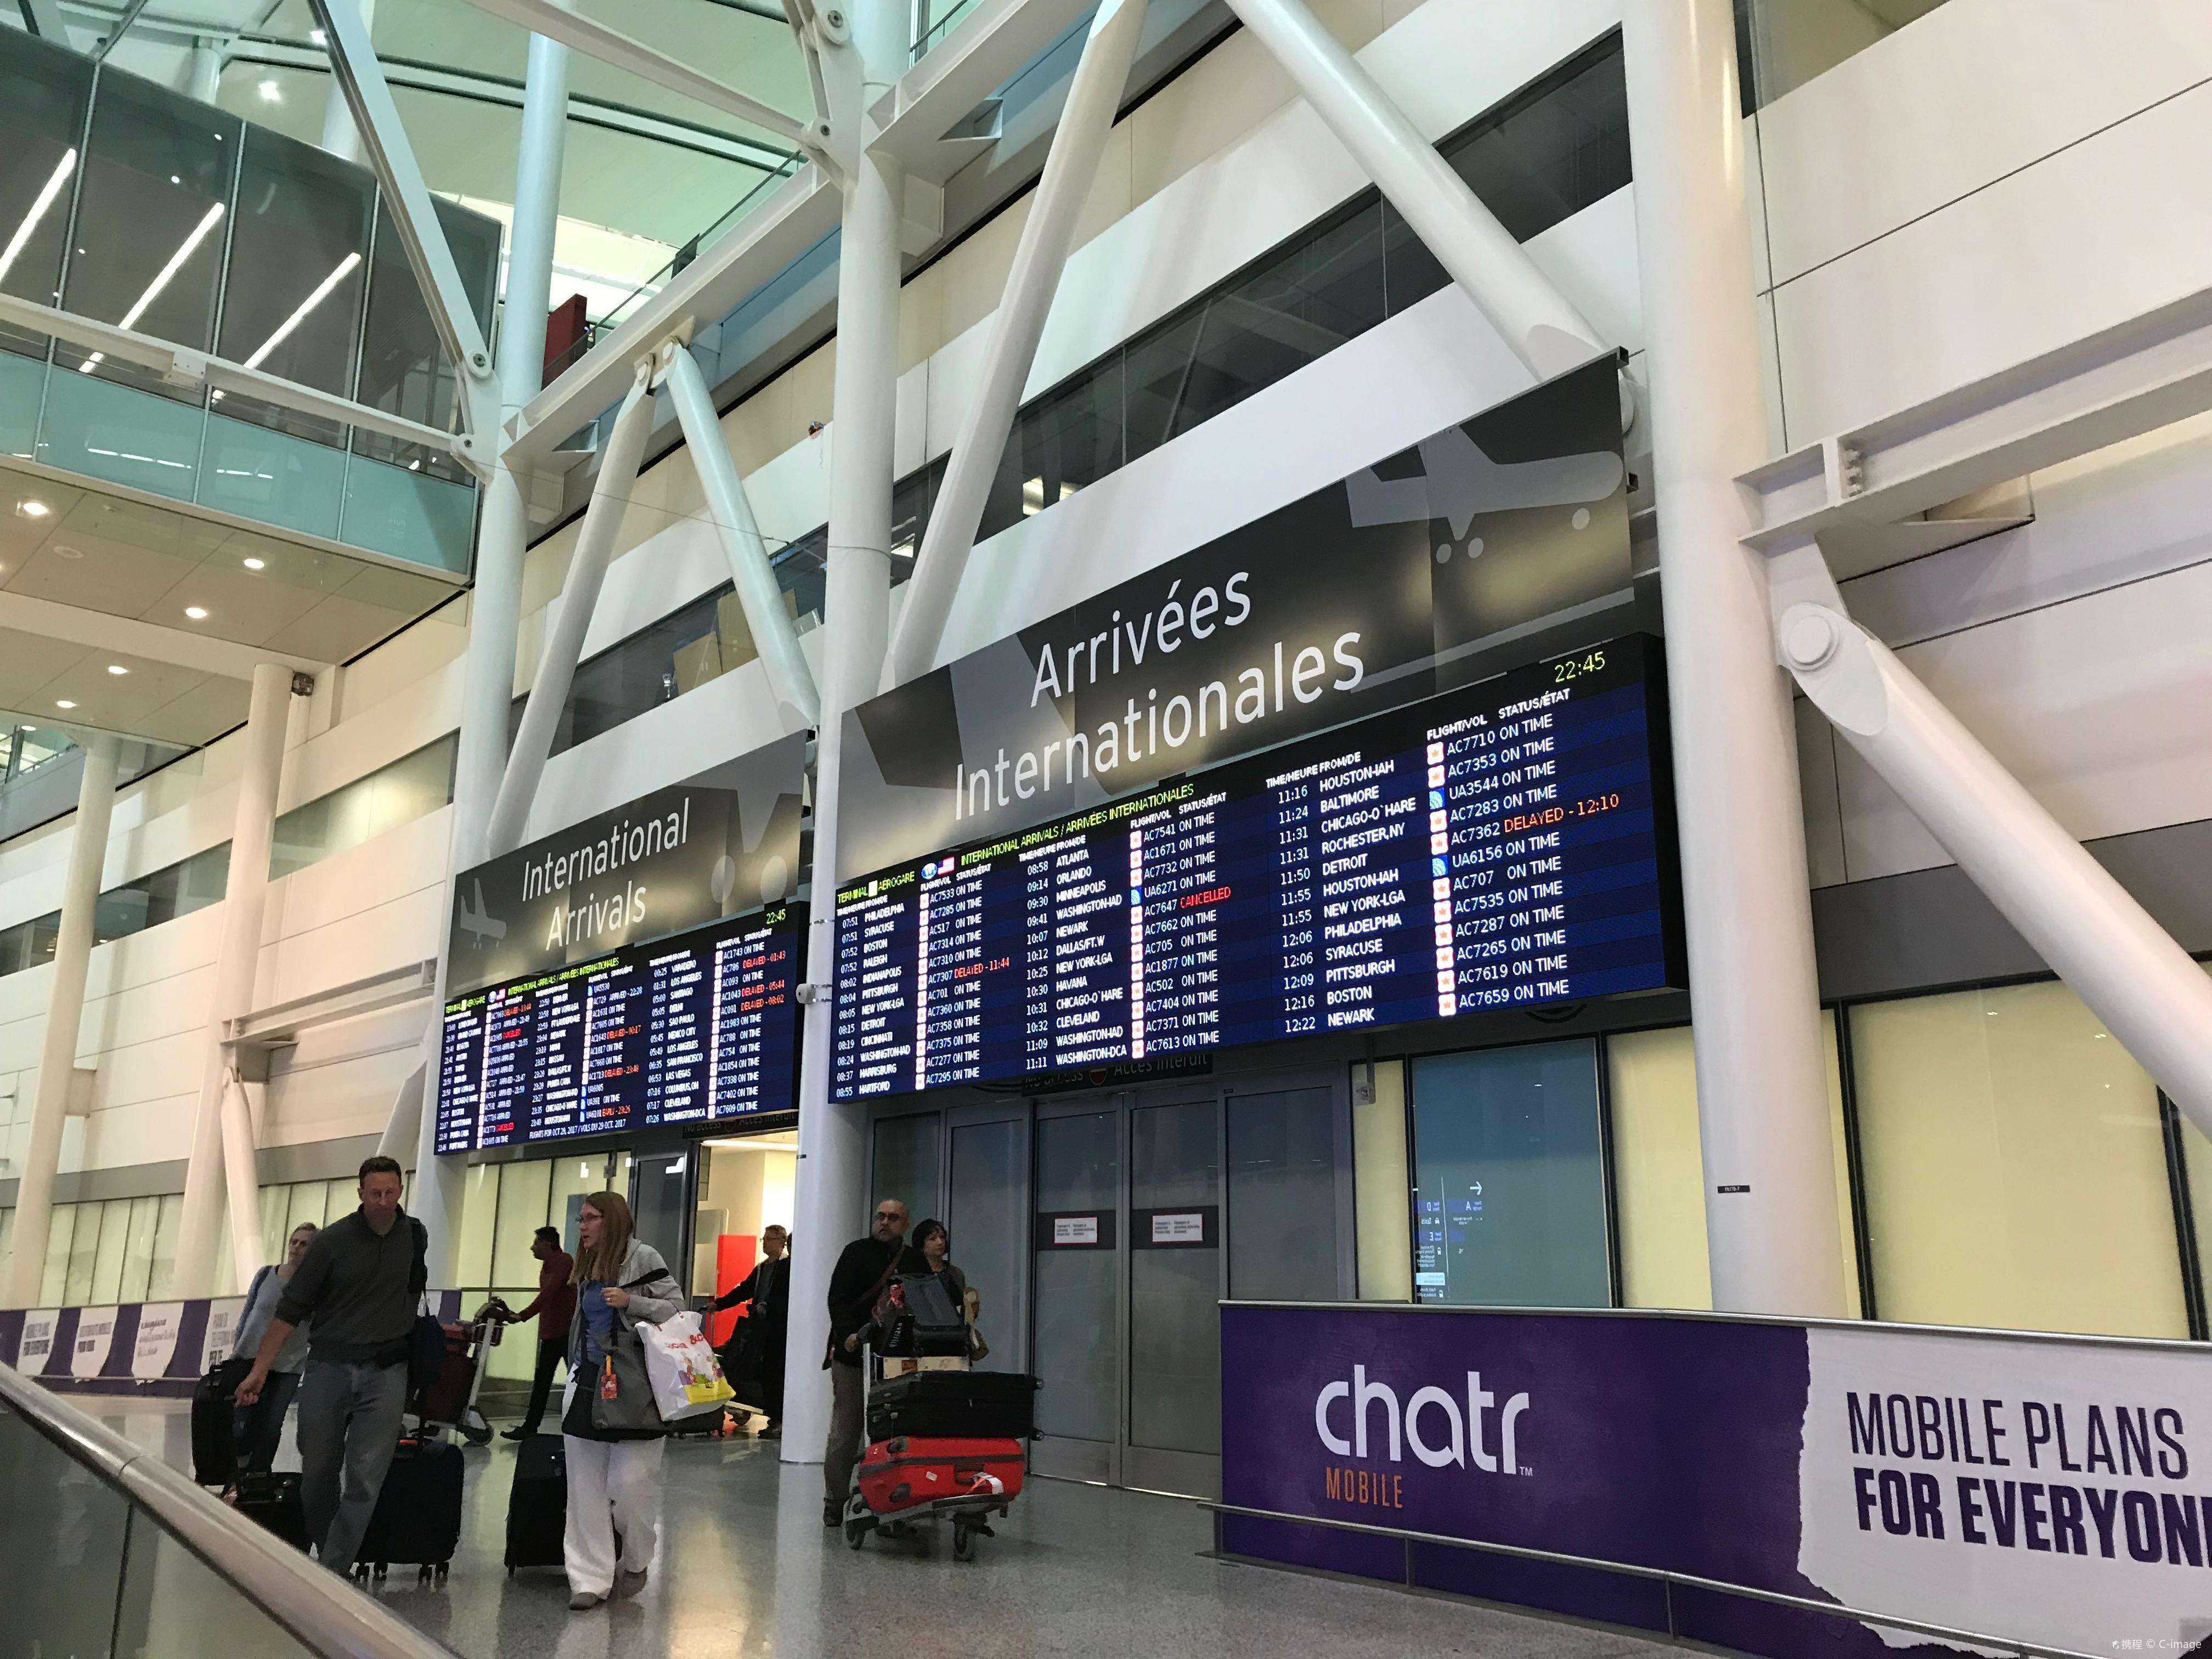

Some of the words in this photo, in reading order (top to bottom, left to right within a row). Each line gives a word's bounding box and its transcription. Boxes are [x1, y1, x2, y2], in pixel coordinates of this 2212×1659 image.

[1031, 571, 1251, 708] Arrivées
[1554, 651, 1605, 682] 22:45
[955, 631, 1363, 820] Internationales
[1278, 785, 1307, 804] 11:16
[1319, 759, 1394, 792] HOUSTON-IAH
[1447, 730, 1495, 755] AC7710
[1499, 723, 1519, 740] ON
[1521, 713, 1553, 733] TIME
[1279, 805, 1308, 824] 11:24
[1320, 785, 1379, 813] BALTIMORE
[1448, 753, 1497, 778] AC7353
[1500, 746, 1520, 763] ON
[1522, 736, 1554, 757] TIME
[1319, 751, 1361, 773] FROM/DE
[961, 838, 1019, 866] INTERNATIONAL
[1020, 826, 1059, 846] ARRIVALS
[1060, 823, 1064, 837] /
[1065, 810, 1107, 833] ARRIVÉES
[1109, 783, 1194, 820] INTERNATIONALES
[1279, 826, 1308, 844] 11:31
[1449, 775, 1499, 799] UA3544
[1502, 769, 1521, 786] ON
[1523, 760, 1555, 780] TIME
[1280, 847, 1309, 865] 11:31
[1322, 822, 1405, 854] ROCHESTER,NY
[1450, 799, 1499, 822] AC7283
[1503, 792, 1522, 809] ON
[1525, 783, 1557, 803] TIME
[522, 797, 689, 902] International
[1027, 860, 1048, 875] 08:58
[1056, 849, 1089, 867] ATLANTA
[1143, 823, 1176, 842] AC7541
[1179, 818, 1192, 832] ON
[1193, 811, 1215, 827] TIME
[1027, 878, 1048, 892] 09:14
[1056, 866, 1092, 884] ORLANDO
[1143, 842, 1176, 861] AC1671
[1179, 837, 1192, 850] ON
[1193, 831, 1215, 847] TIME
[1280, 867, 1310, 885] 11:50
[1322, 853, 1368, 876] DETROIT
[1451, 822, 1500, 845] AC7362
[1504, 807, 1564, 832] DELAYED
[1577, 794, 1619, 815] 12:10
[1282, 888, 1311, 906] 11:55
[1323, 868, 1398, 896] HOUSTON-IAH
[1452, 845, 1503, 867] UA6156
[1506, 839, 1525, 856] ON
[1527, 832, 1560, 851] TIME
[546, 881, 646, 951] Arrivals
[766, 909, 786, 924] 22:45
[1027, 930, 1048, 945] 10:07
[1056, 920, 1088, 938] NEWARK
[1144, 899, 1177, 917] AC7647
[1180, 886, 1231, 909] CANCELLED
[1282, 909, 1312, 926] 11:55
[1324, 901, 1349, 918] NEW
[1351, 889, 1406, 912] YORK-LGA
[1453, 870, 1494, 891] AC707
[1507, 863, 1526, 879] ON
[1529, 856, 1561, 874] TIME
[1283, 930, 1312, 947] 12:06
[1324, 912, 1402, 939] PHILADELPHIA
[1454, 891, 1504, 914] AC7535
[1508, 887, 1527, 903] ON
[1531, 880, 1563, 899] TIME
[1026, 948, 1048, 962] 10:12
[1056, 934, 1105, 956] DALLAS/FT.W
[1144, 918, 1178, 936] AC7662
[1180, 915, 1193, 928] ON
[1195, 909, 1216, 924] TIME
[1026, 966, 1048, 980] 10:25
[1056, 960, 1074, 974] NEW
[1075, 952, 1113, 969] YORK-LGA
[1144, 939, 1172, 955] AC705
[1181, 934, 1194, 947] ON
[1195, 929, 1217, 944] TIME
[1283, 951, 1313, 968] 12:06
[1325, 938, 1383, 961] SYRACUSE
[1455, 916, 1505, 937] AC7287
[1509, 911, 1529, 927] ON
[1532, 904, 1564, 923] TIME
[1284, 973, 1314, 990] 12:09
[1326, 958, 1395, 983] PITTSBURGH
[1457, 939, 1506, 961] AC7265
[1511, 935, 1530, 951] ON
[1533, 929, 1566, 947] TIME
[1284, 995, 1314, 1011] 12:16
[1327, 985, 1372, 1005] BOSTON
[1458, 964, 1508, 984] AC7619
[1513, 960, 1532, 975] ON
[1534, 954, 1567, 972] TIME
[1285, 1016, 1316, 1032] 12:22
[1328, 1007, 1374, 1026] NEWARK
[1459, 988, 1509, 1008] AC7659
[1514, 984, 1533, 1000] ON
[1536, 979, 1569, 997] TIME
[1026, 1056, 1047, 1070] 11:11
[1055, 1044, 1127, 1065] WASHINGTON-DCA
[1146, 1036, 1180, 1052] AC7613
[1182, 1034, 1195, 1046] ON
[1197, 1030, 1219, 1044] TIME
[1316, 1364, 1529, 1475] chatr
[1847, 1391, 2010, 1466] MOBILE
[2022, 1401, 2188, 1480] PLANS
[1326, 1466, 1403, 1509] MOBILE
[1853, 1466, 1945, 1540] FOR
